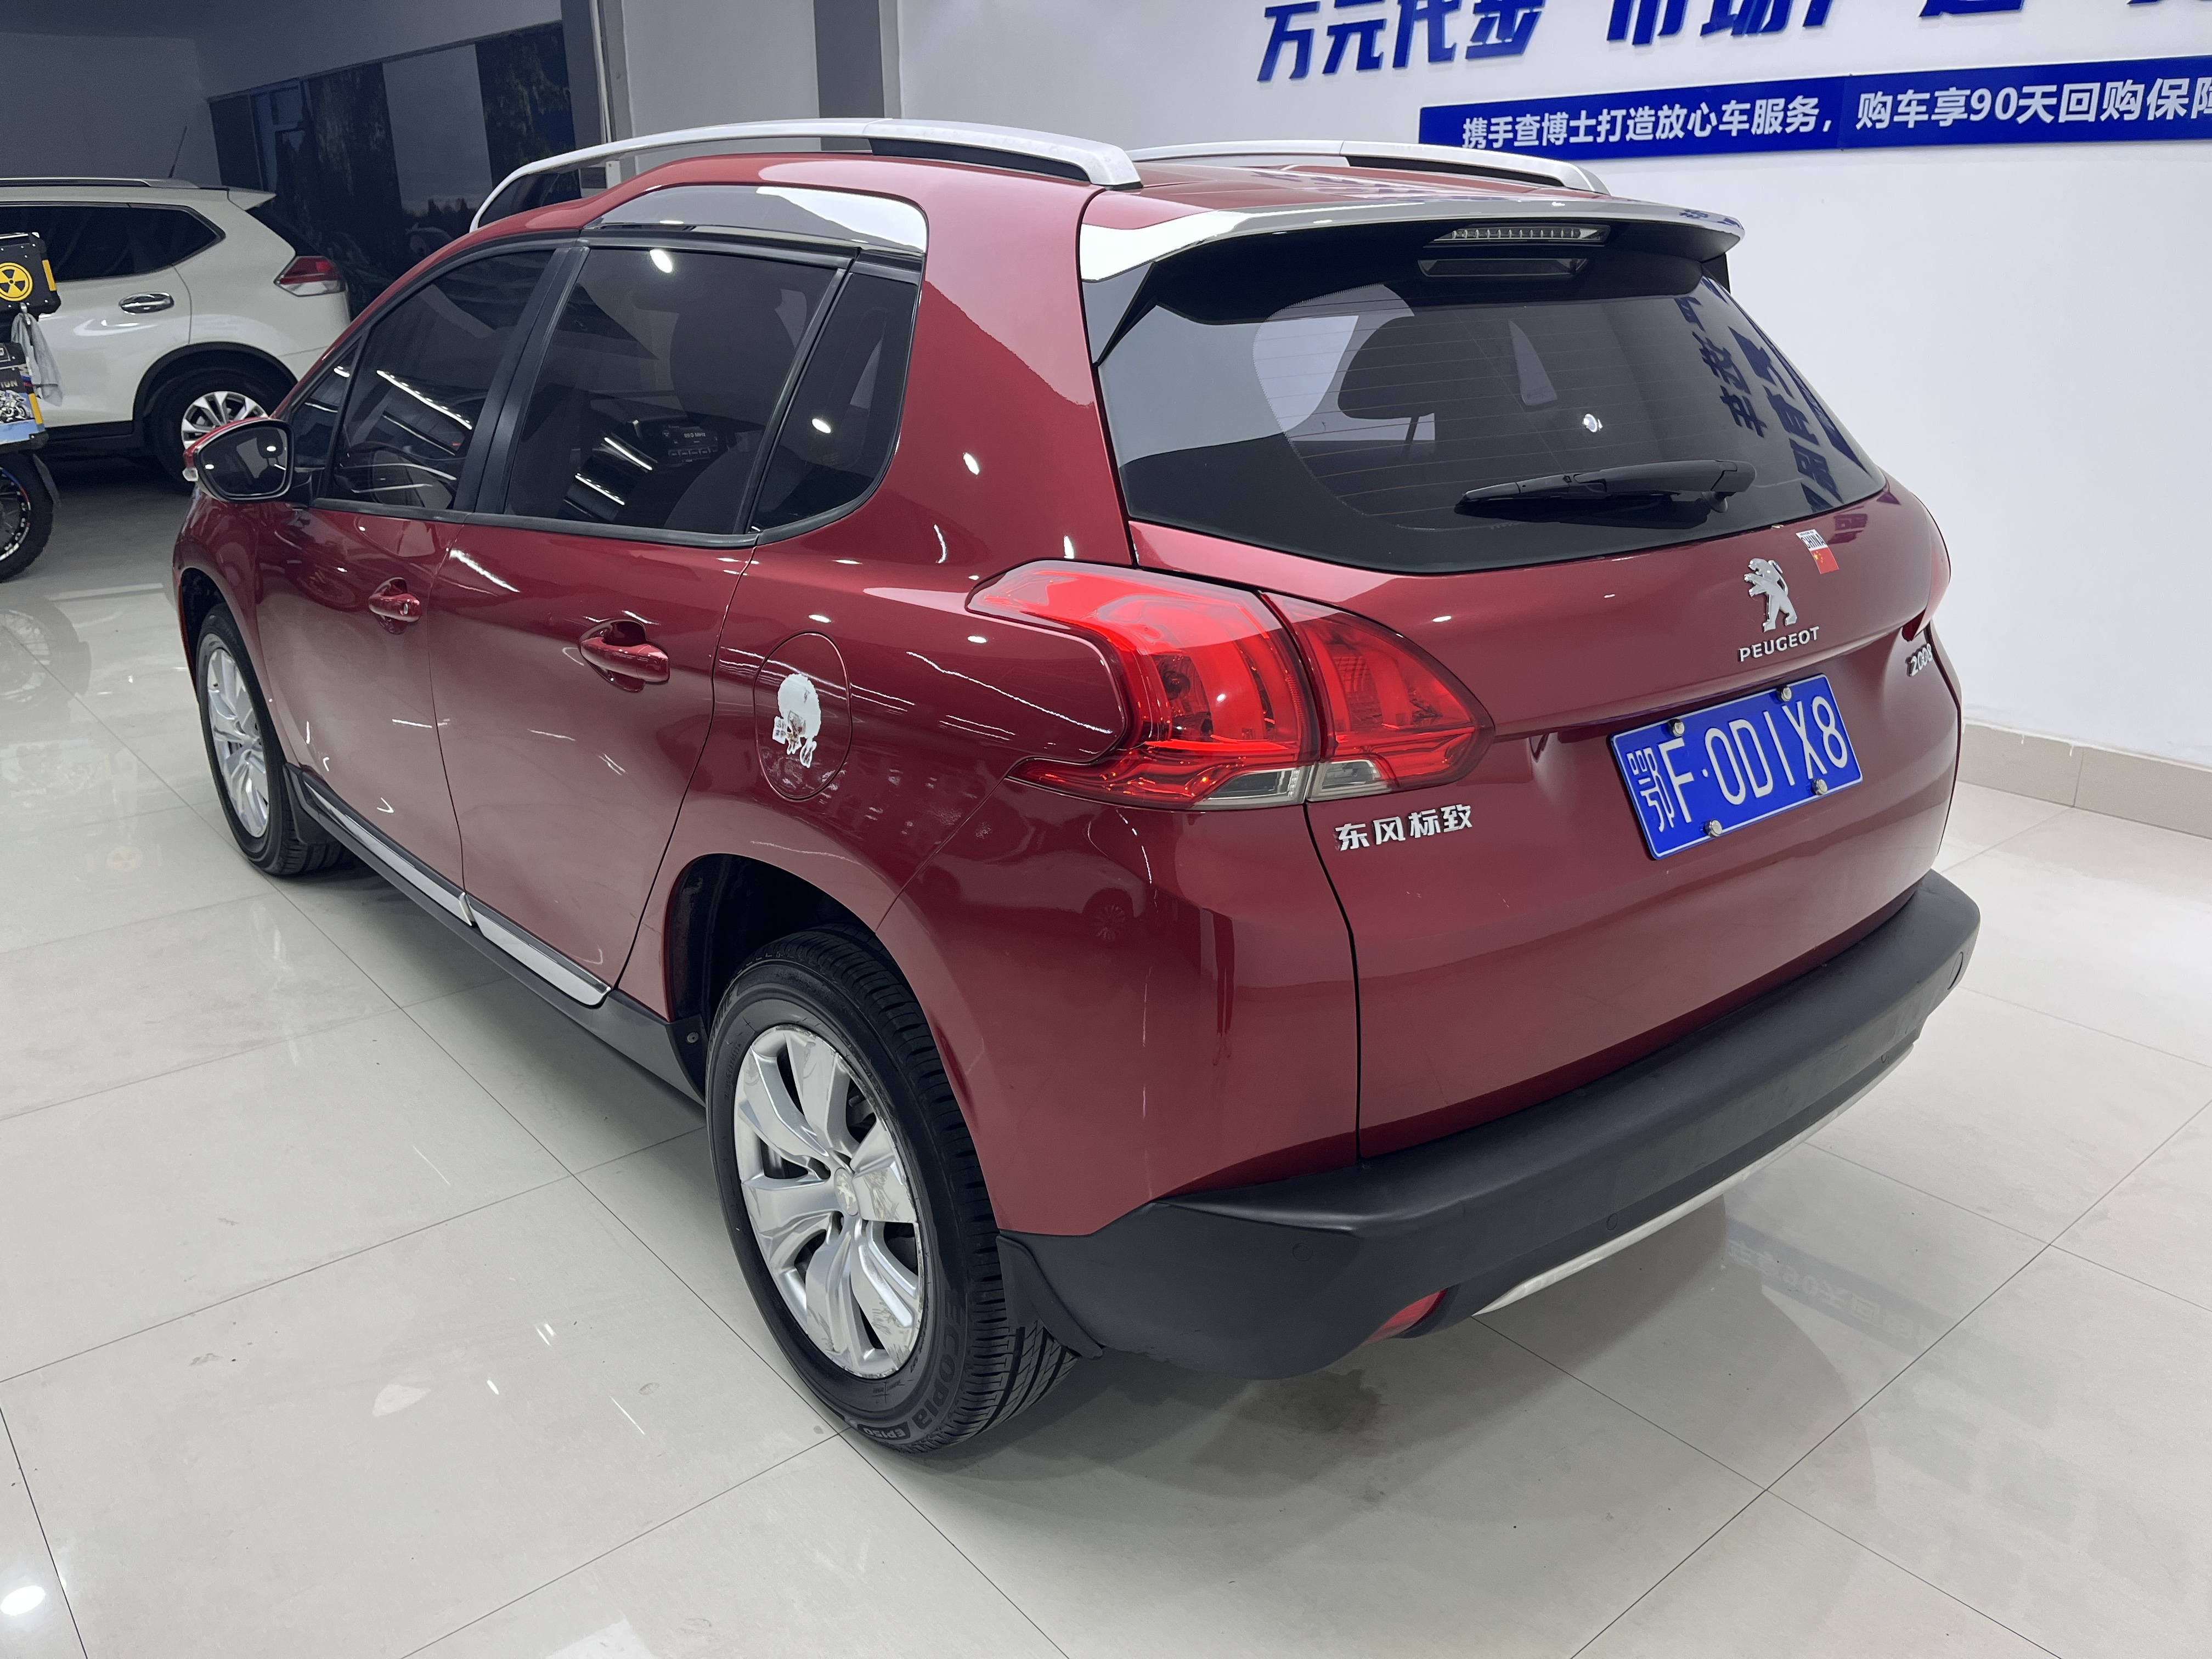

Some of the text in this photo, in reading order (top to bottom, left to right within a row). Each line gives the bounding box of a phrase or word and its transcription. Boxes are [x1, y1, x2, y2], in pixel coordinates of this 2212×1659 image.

[1801, 533, 1827, 549] CHINA
[1739, 627, 1820, 662] PEUGEOT
[1905, 642, 1933, 677] 2008
[1334, 803, 1473, 851] 东风标致
